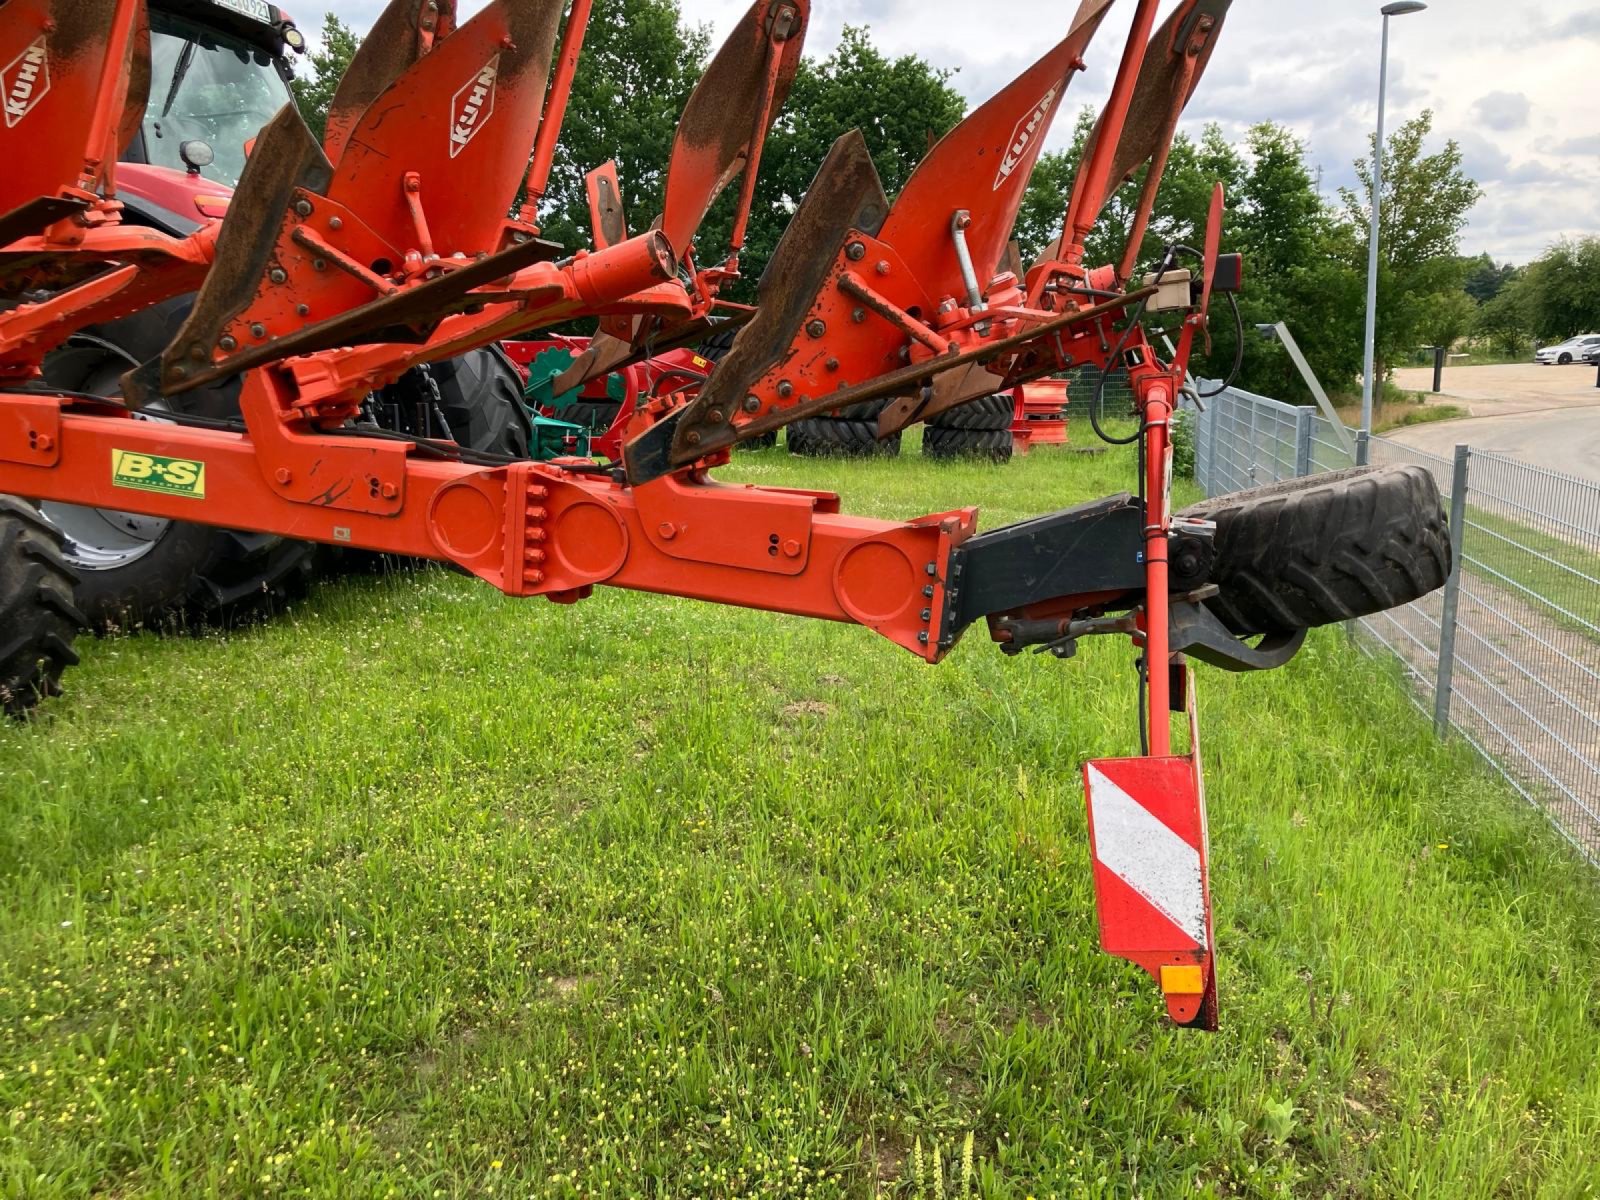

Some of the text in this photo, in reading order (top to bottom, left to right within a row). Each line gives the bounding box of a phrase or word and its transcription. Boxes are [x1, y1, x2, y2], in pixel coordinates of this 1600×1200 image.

[6, 46, 45, 116] KUHN
[451, 65, 497, 145] KUHN
[1000, 88, 1056, 176] KUHN
[117, 453, 198, 485] B+S
